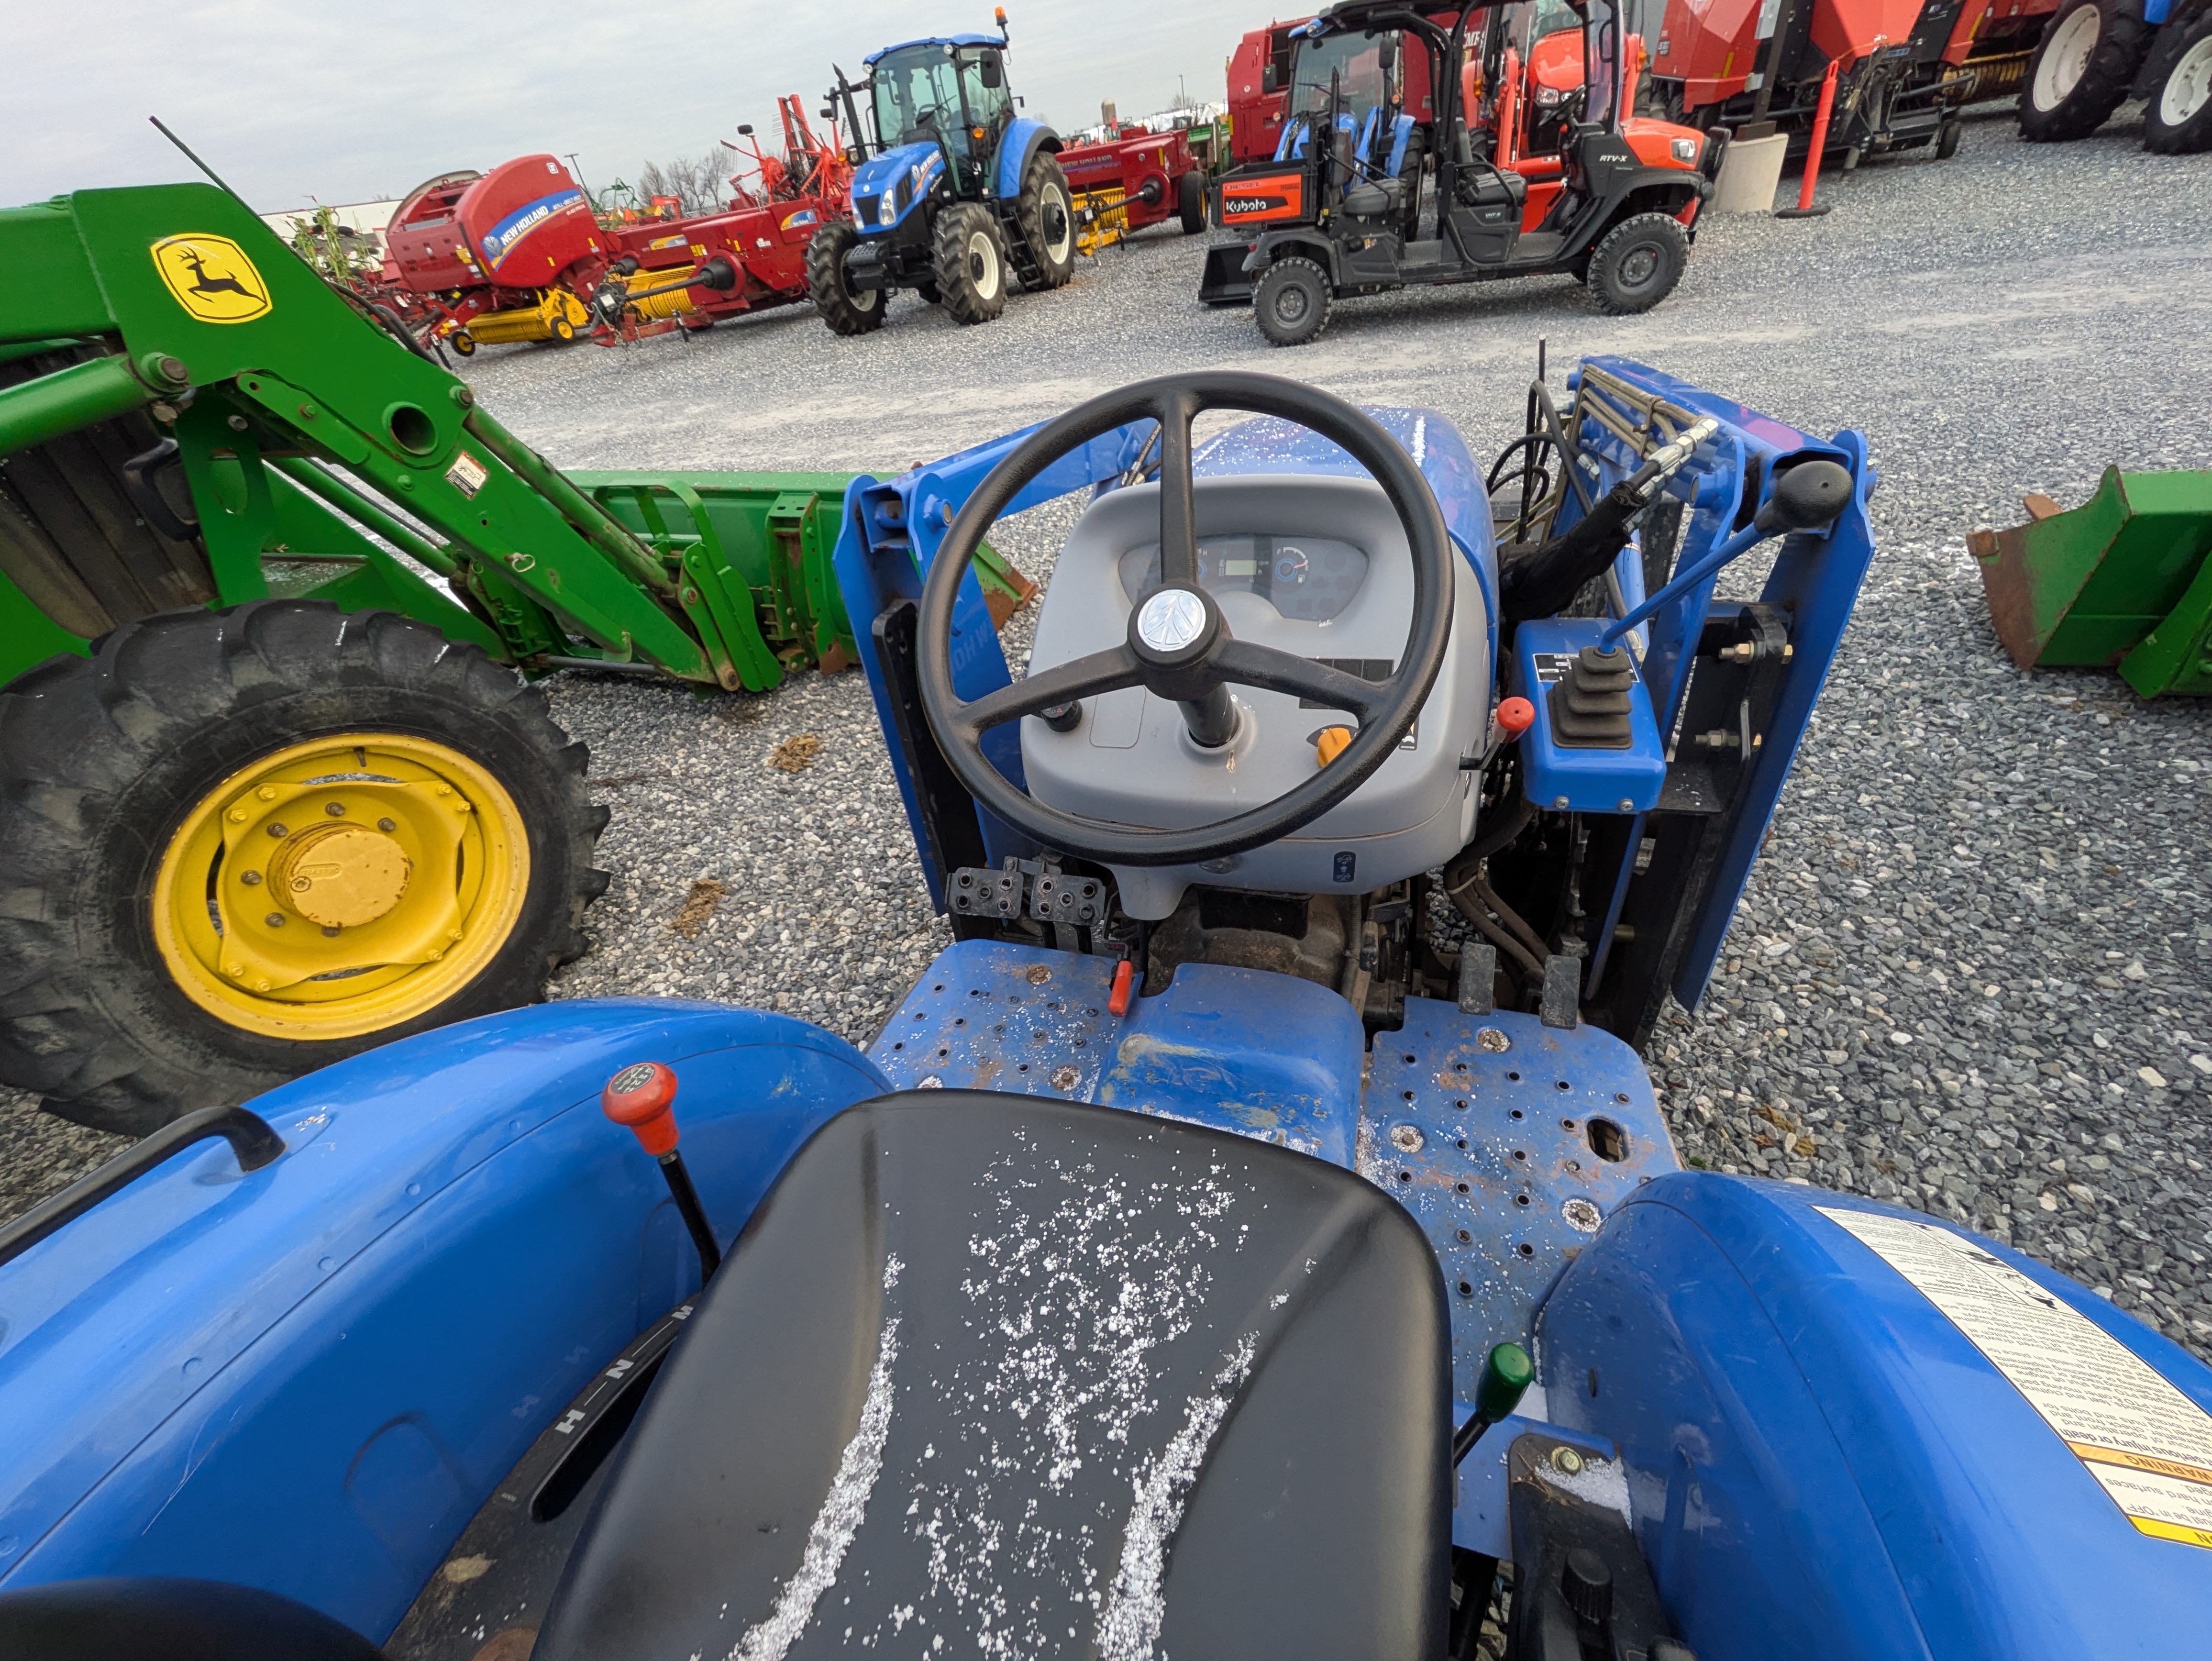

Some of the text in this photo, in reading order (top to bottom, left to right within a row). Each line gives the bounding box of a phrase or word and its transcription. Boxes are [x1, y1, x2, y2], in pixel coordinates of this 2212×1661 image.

[1226, 199, 1266, 212] Kubota
[500, 228, 519, 246] NEW
[518, 206, 549, 232] HOLLAND
[606, 1359, 634, 1379] N
[2124, 1398, 2150, 1408] PTO
[555, 1409, 586, 1435] H
[2093, 1412, 2117, 1420] and
[2061, 1419, 2085, 1427] and
[2147, 1422, 2172, 1433] lug
[2059, 1428, 2097, 1442] death
[2087, 1424, 2147, 1439] operation
[2112, 1437, 2155, 1454] injury
[2167, 1440, 2198, 1452] hour
[2152, 1447, 2205, 1463] serious
[2124, 1455, 2212, 1480] WARNING
[2105, 1478, 2163, 1494] surfaces
[2166, 1491, 2201, 1504] hard
[2158, 1509, 2174, 1519] in
[2173, 1513, 2192, 1523] be
